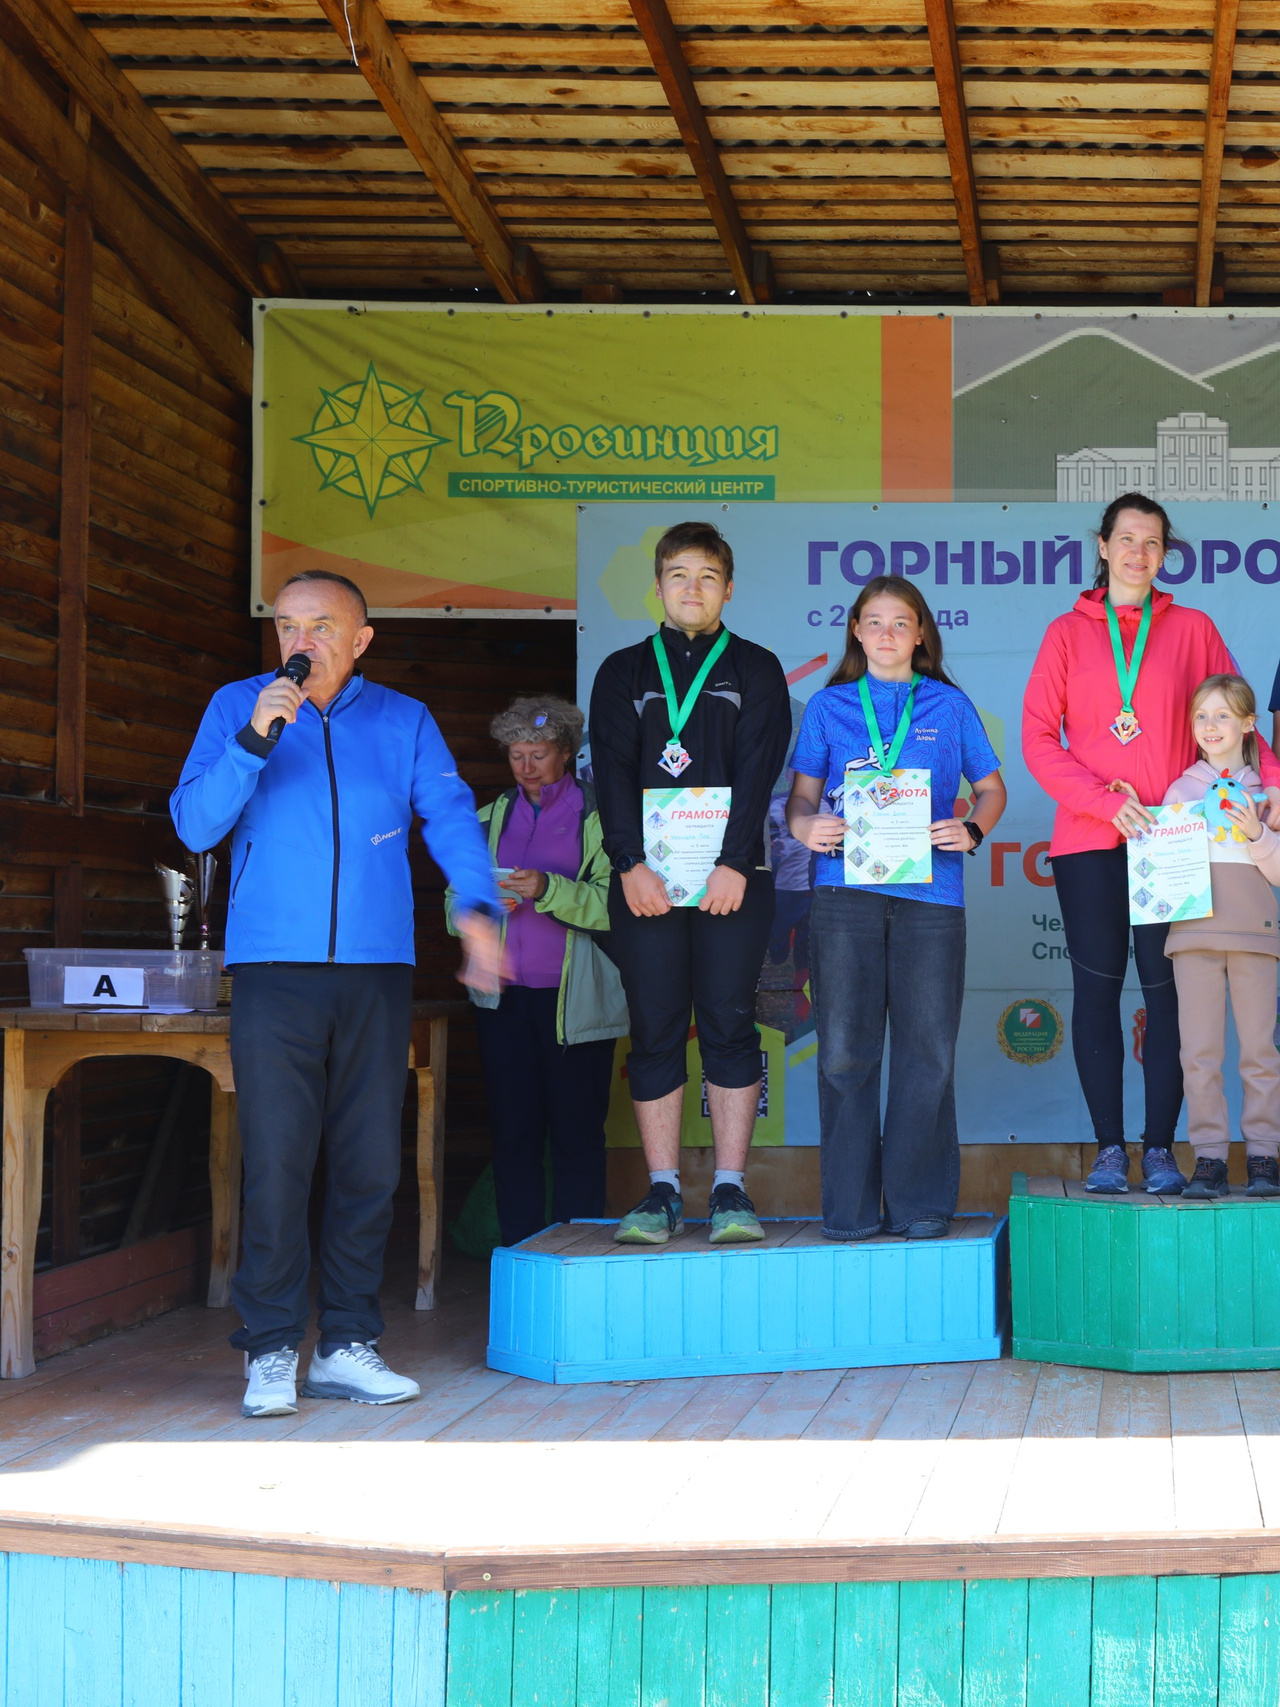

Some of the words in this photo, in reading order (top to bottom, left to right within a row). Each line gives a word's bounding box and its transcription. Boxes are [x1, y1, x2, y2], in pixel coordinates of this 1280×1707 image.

[441, 390, 778, 470] Провинция
[459, 478, 705, 495] СПОРТИВНО-ТУРИСТИЧЕСКИЙ
[710, 481, 764, 497] ЦЕНТР
[808, 535, 1082, 586] ГОРНЫЙ
[681, 753, 689, 762] 2
[889, 788, 898, 797] 2
[671, 810, 729, 820] ГРАМОТА
[1154, 821, 1205, 838] ГРАМОТА
